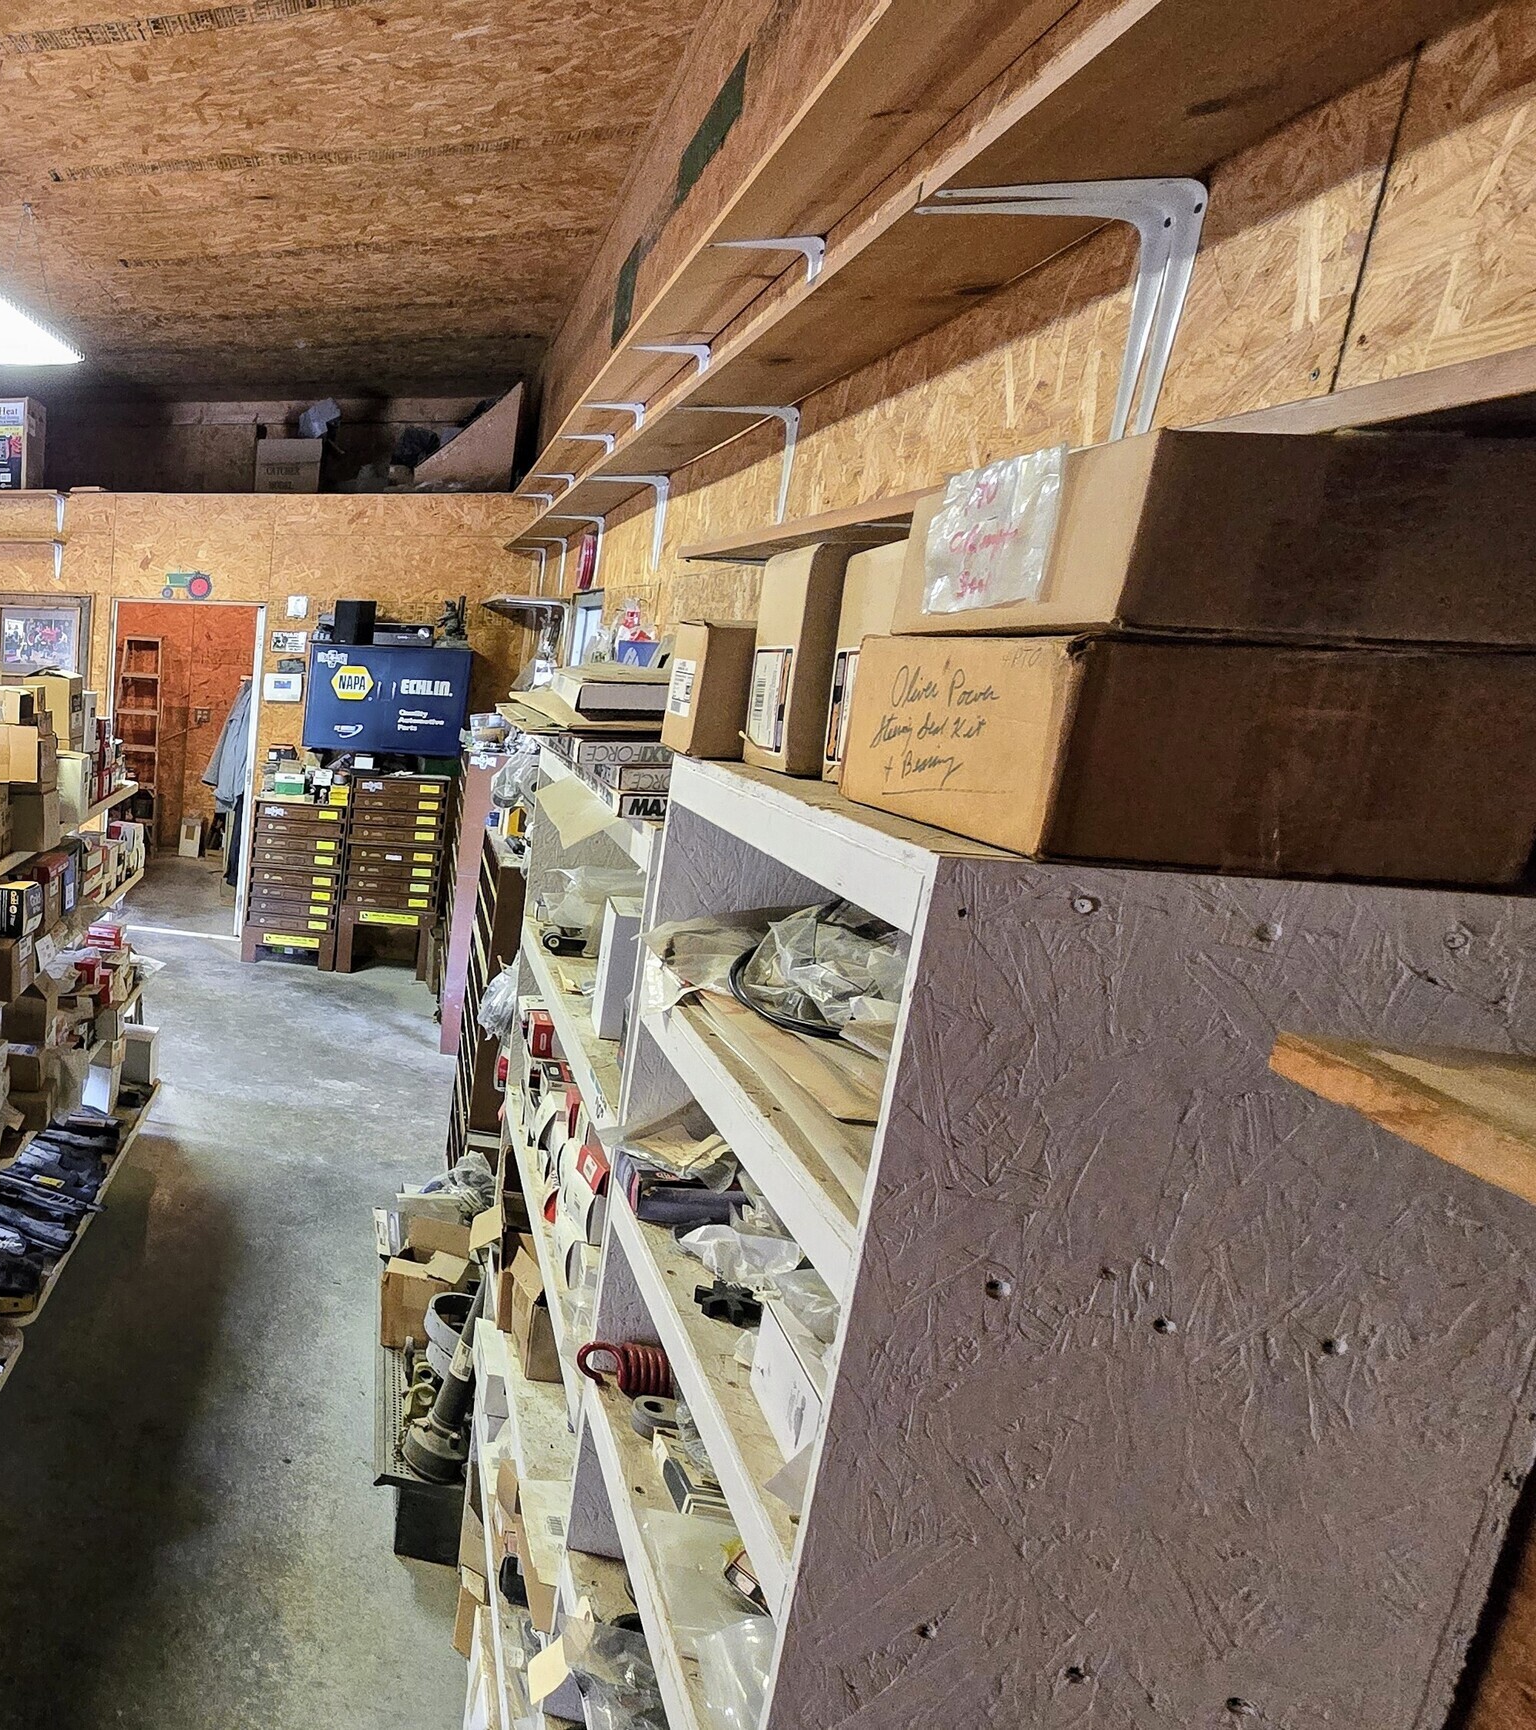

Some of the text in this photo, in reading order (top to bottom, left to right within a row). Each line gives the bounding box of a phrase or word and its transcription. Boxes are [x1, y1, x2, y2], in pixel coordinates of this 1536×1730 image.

[0, 406, 18, 416] Heat
[338, 674, 366, 691] NAPA
[891, 664, 1001, 708] Oliver Power
[398, 708, 429, 719] Quality
[396, 724, 418, 732] Parts
[397, 717, 445, 726] Automotive
[950, 714, 988, 740] Kit
[585, 745, 674, 763] AXIFORCE
